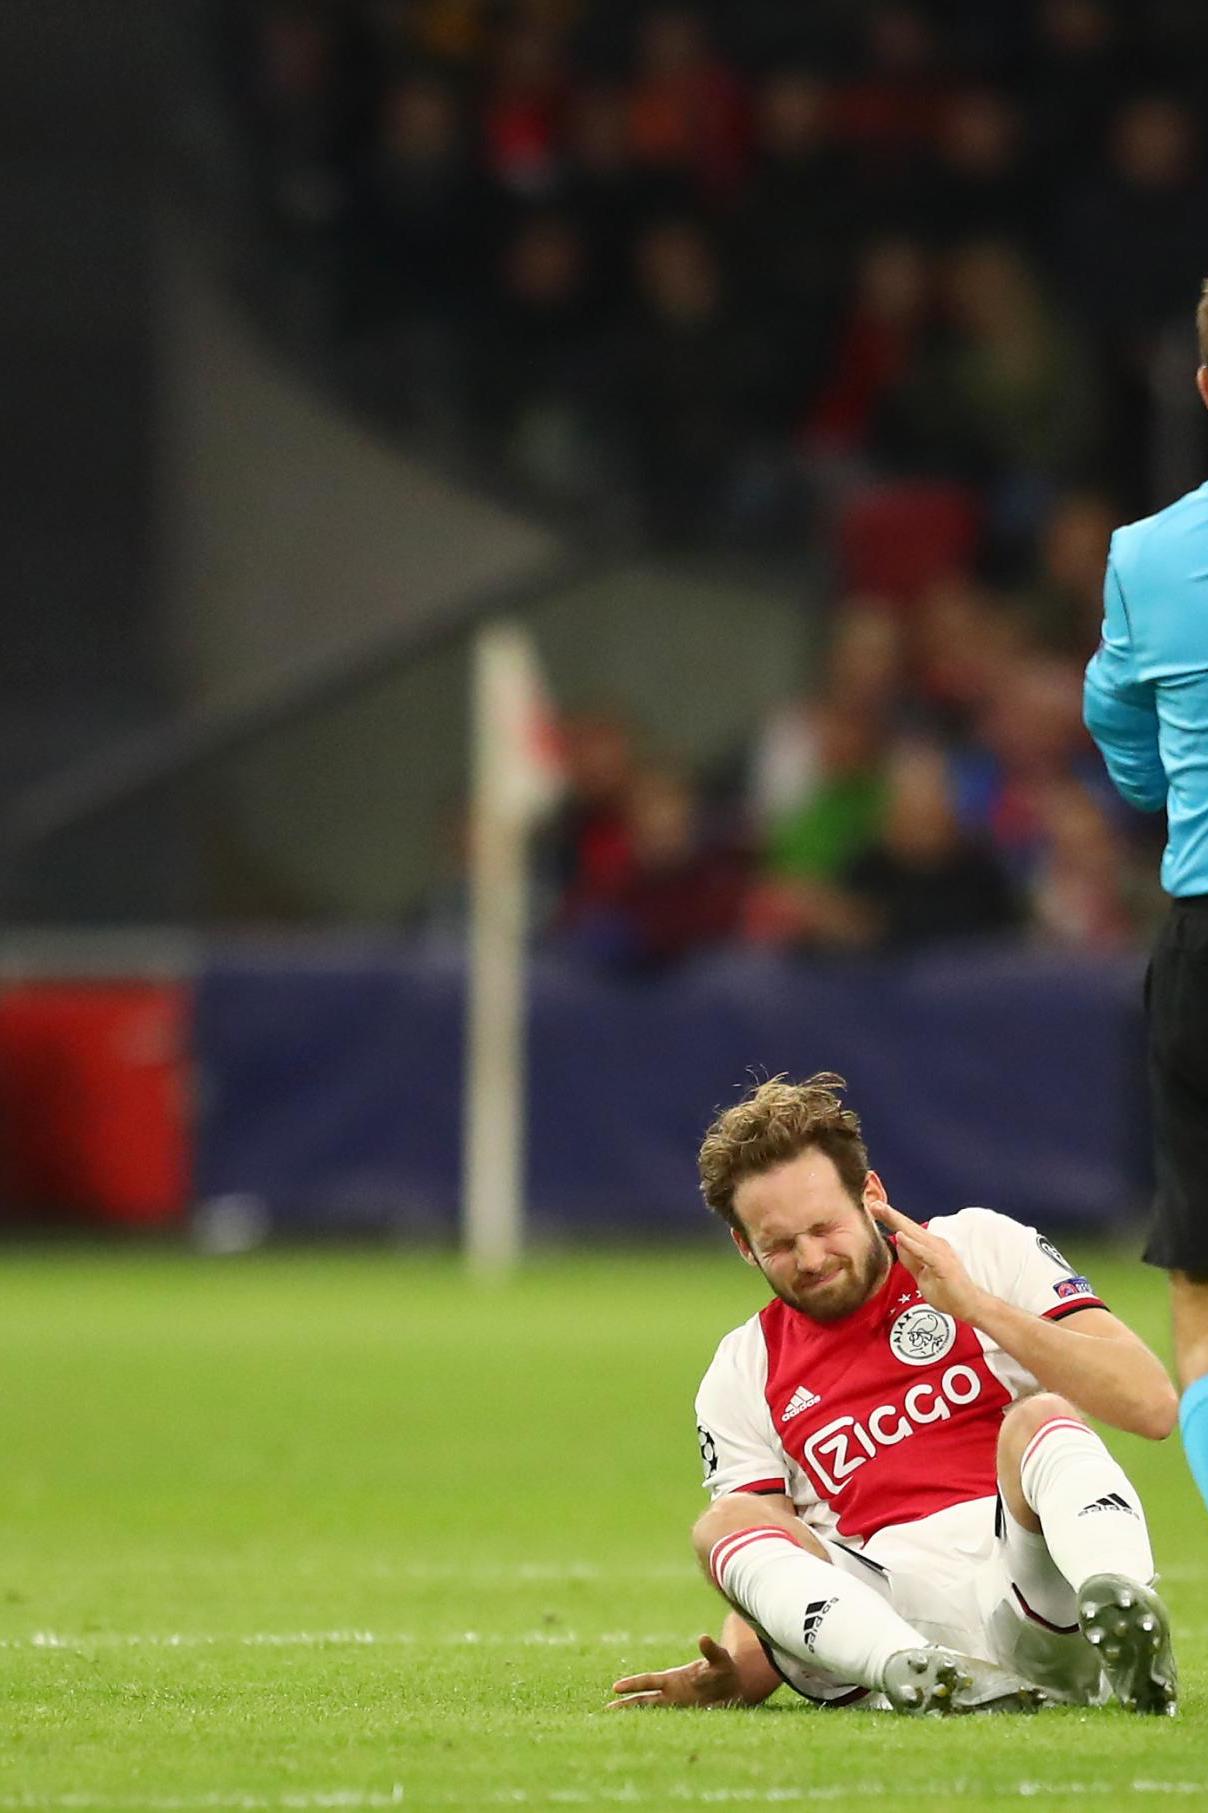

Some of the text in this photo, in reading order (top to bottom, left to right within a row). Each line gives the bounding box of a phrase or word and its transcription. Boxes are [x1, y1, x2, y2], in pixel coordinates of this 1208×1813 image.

[893, 1313, 912, 1343] AJAX
[781, 1394, 821, 1422] adidas
[806, 1364, 981, 1490] ZIGGO
